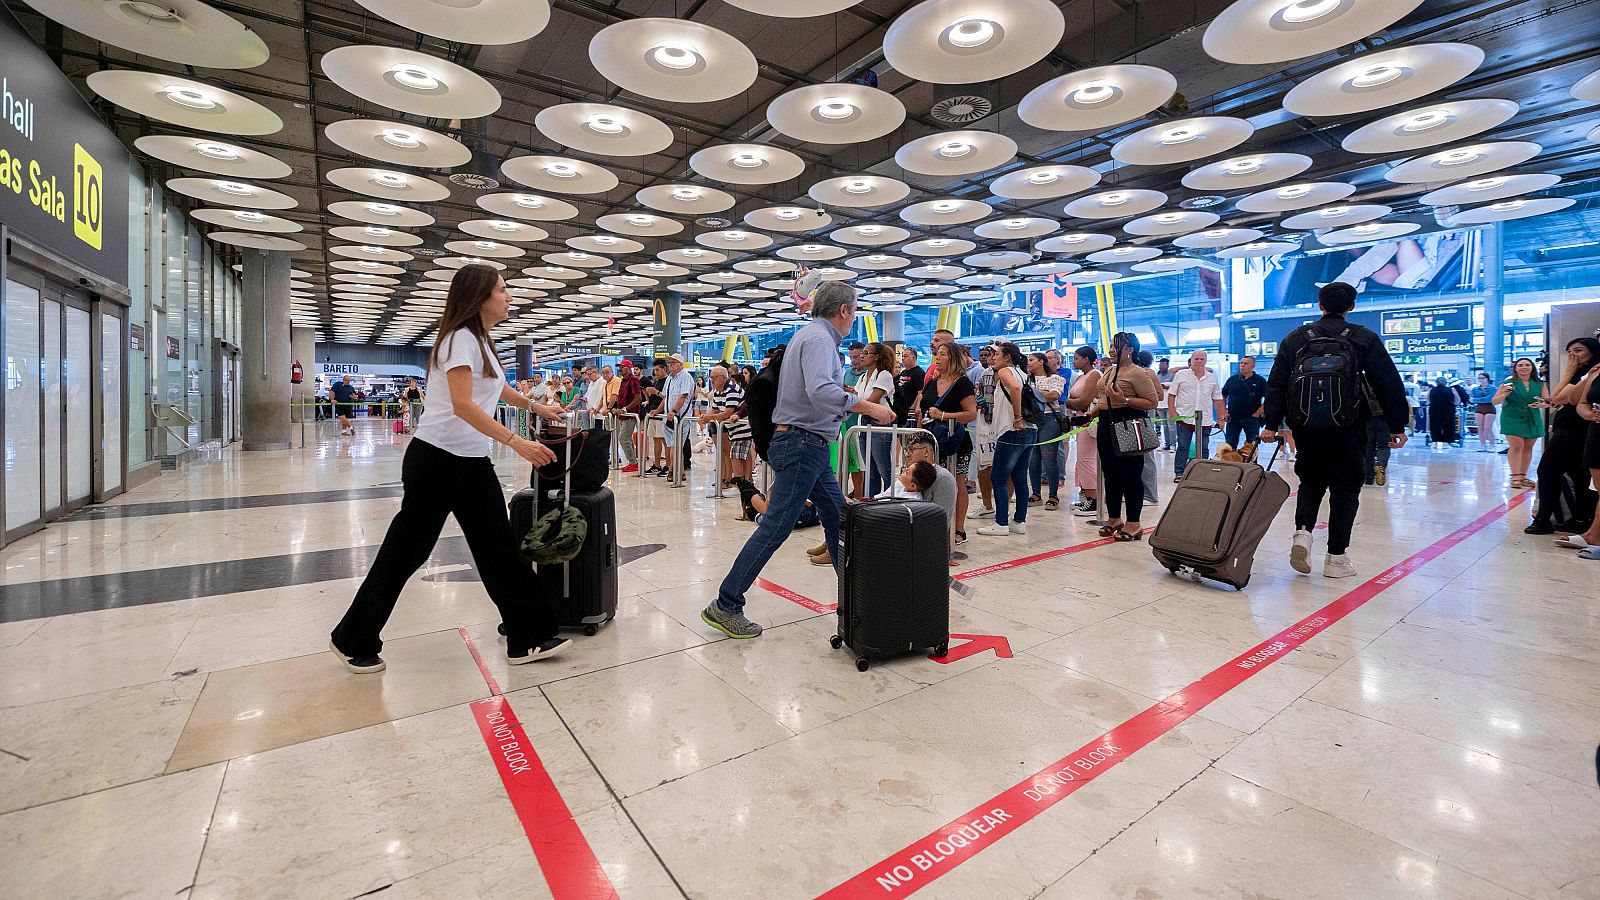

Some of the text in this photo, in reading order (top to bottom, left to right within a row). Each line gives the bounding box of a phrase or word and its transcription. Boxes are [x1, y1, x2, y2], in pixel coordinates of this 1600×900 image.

[3, 77, 34, 142] hall
[29, 159, 65, 223] Sala
[77, 163, 100, 232] 10
[323, 364, 359, 373] BARETO
[1439, 343, 1471, 351] Ciudad
[1237, 660, 1257, 669] NO
[486, 711, 531, 775] DO NOT BLOCK
[1023, 743, 1122, 802] DO NOT BLOCK
[875, 807, 1013, 893] NO BLOQUEAR
